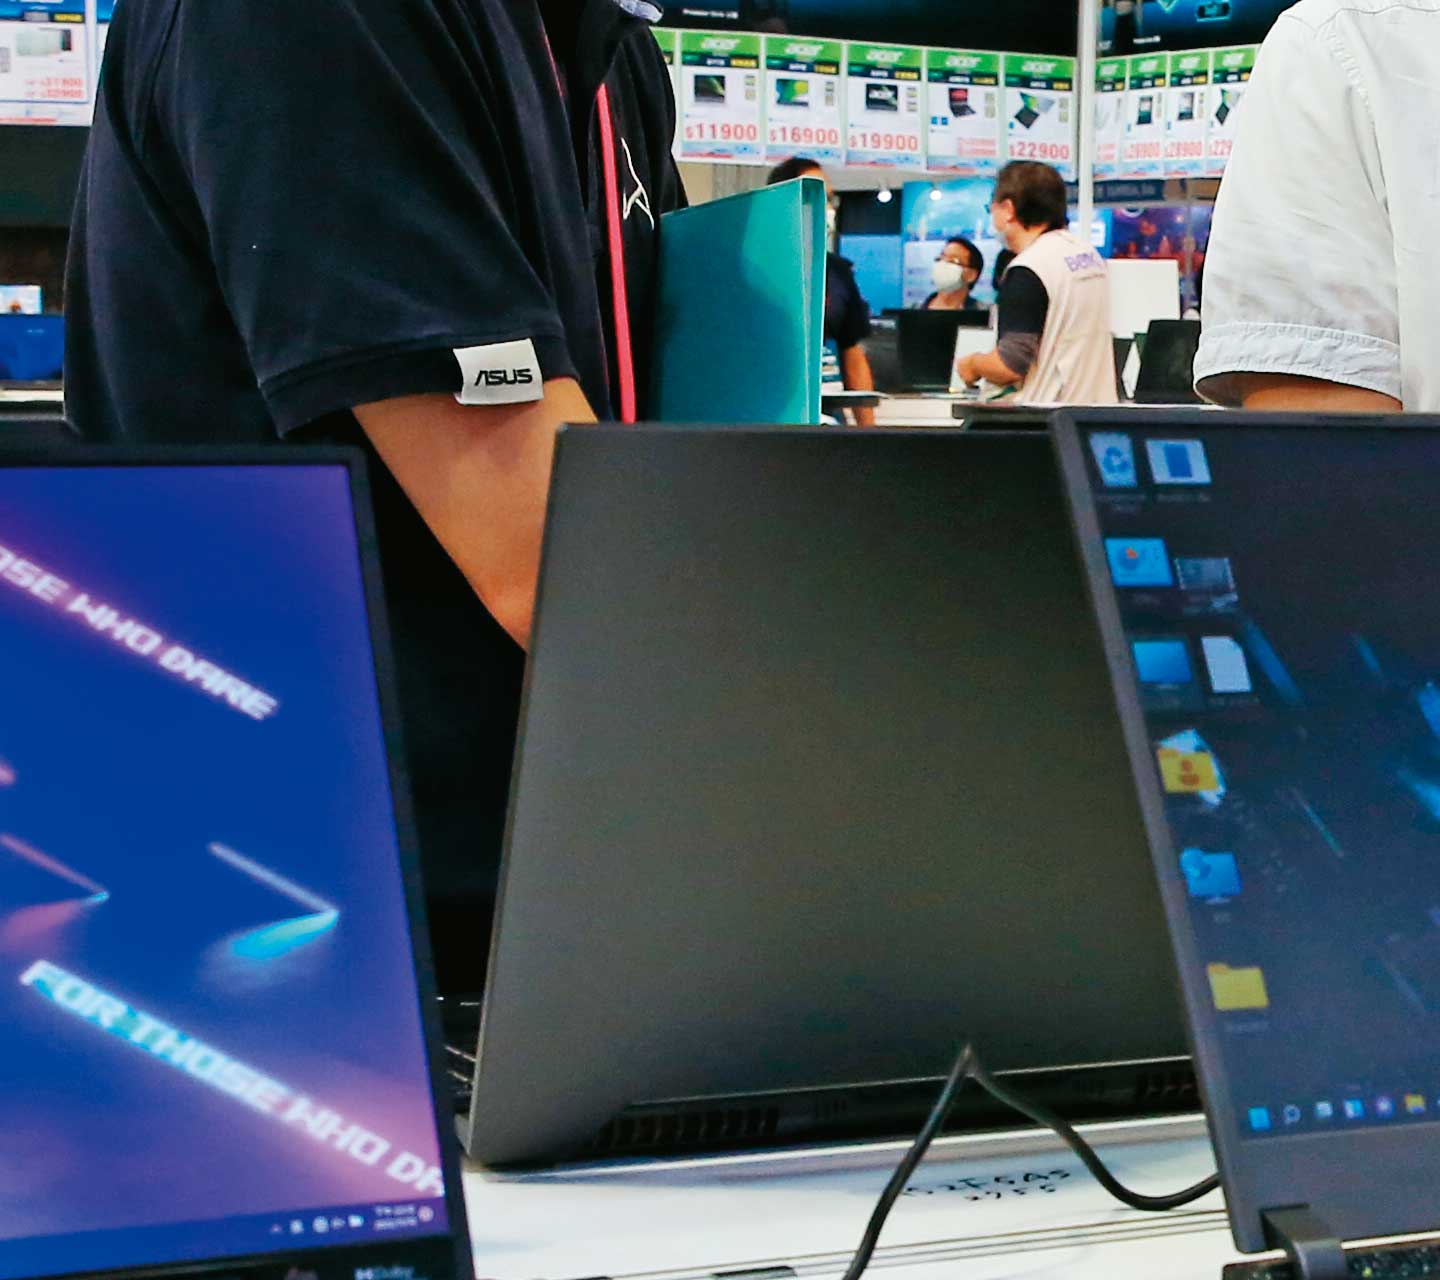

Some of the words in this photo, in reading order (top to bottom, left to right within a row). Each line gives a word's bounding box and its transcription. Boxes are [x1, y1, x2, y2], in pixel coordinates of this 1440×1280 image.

[685, 122, 757, 143] $11900
[474, 369, 533, 387] ASUS
[67, 594, 161, 656] WHO
[161, 645, 278, 720] DARE
[129, 1013, 280, 1113] THOSE
[285, 1091, 390, 1166] WHO
